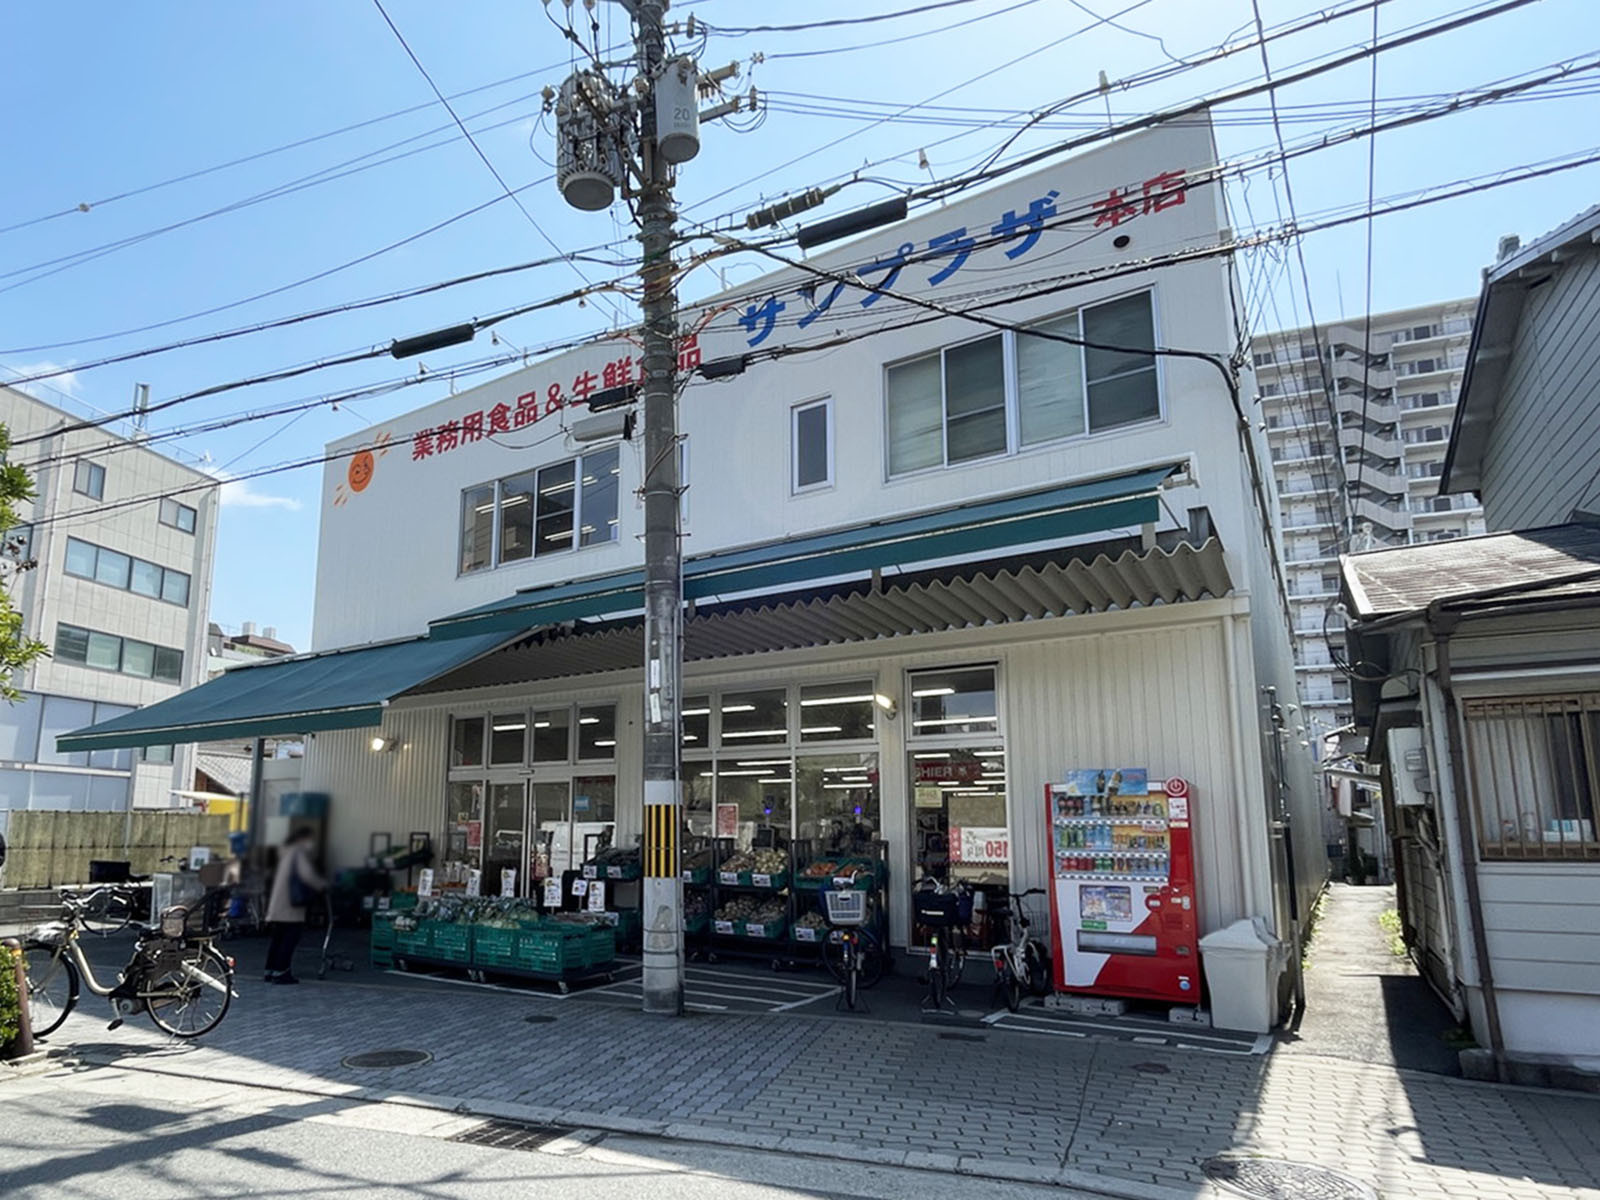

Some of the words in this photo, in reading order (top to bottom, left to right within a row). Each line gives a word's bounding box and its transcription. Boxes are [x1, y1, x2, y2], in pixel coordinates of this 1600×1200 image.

[673, 107, 690, 121] 20
[738, 189, 1061, 348] サンプラザ
[1092, 168, 1187, 228] 本店
[412, 332, 703, 462] 業務用食品&生鮮品
